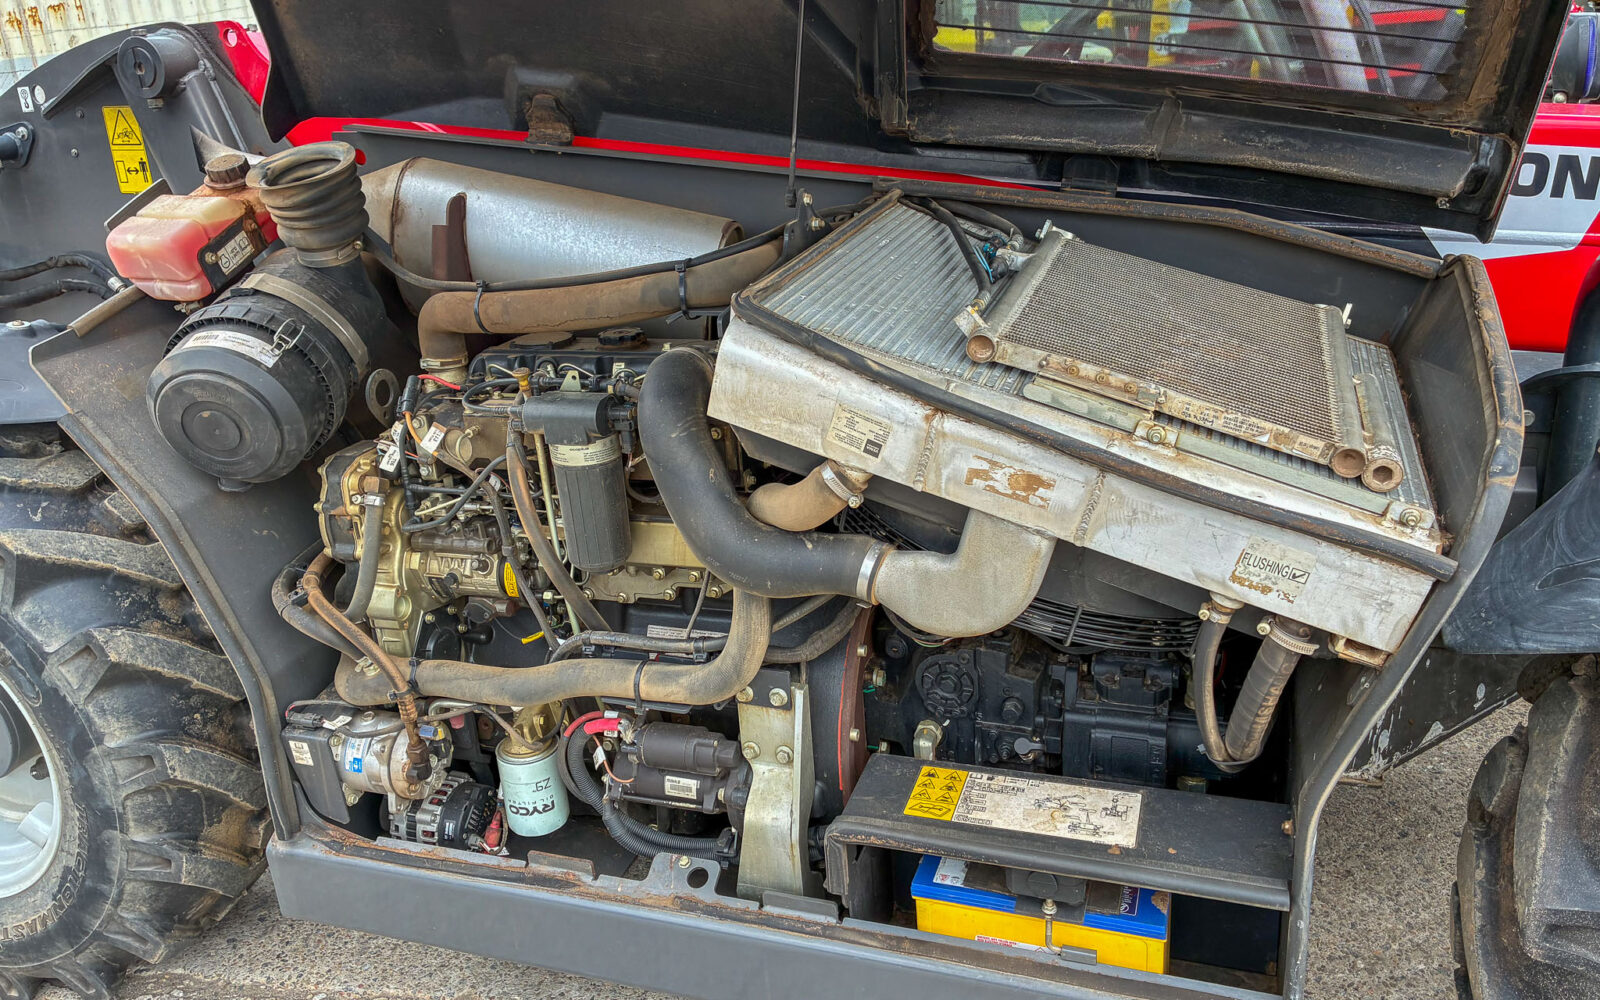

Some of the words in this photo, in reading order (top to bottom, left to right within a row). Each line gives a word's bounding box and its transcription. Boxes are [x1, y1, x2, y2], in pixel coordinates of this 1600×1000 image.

[1241, 552, 1290, 578] FLUSHING
[540, 794, 554, 803] OIL
[508, 800, 556, 817] RYCO
